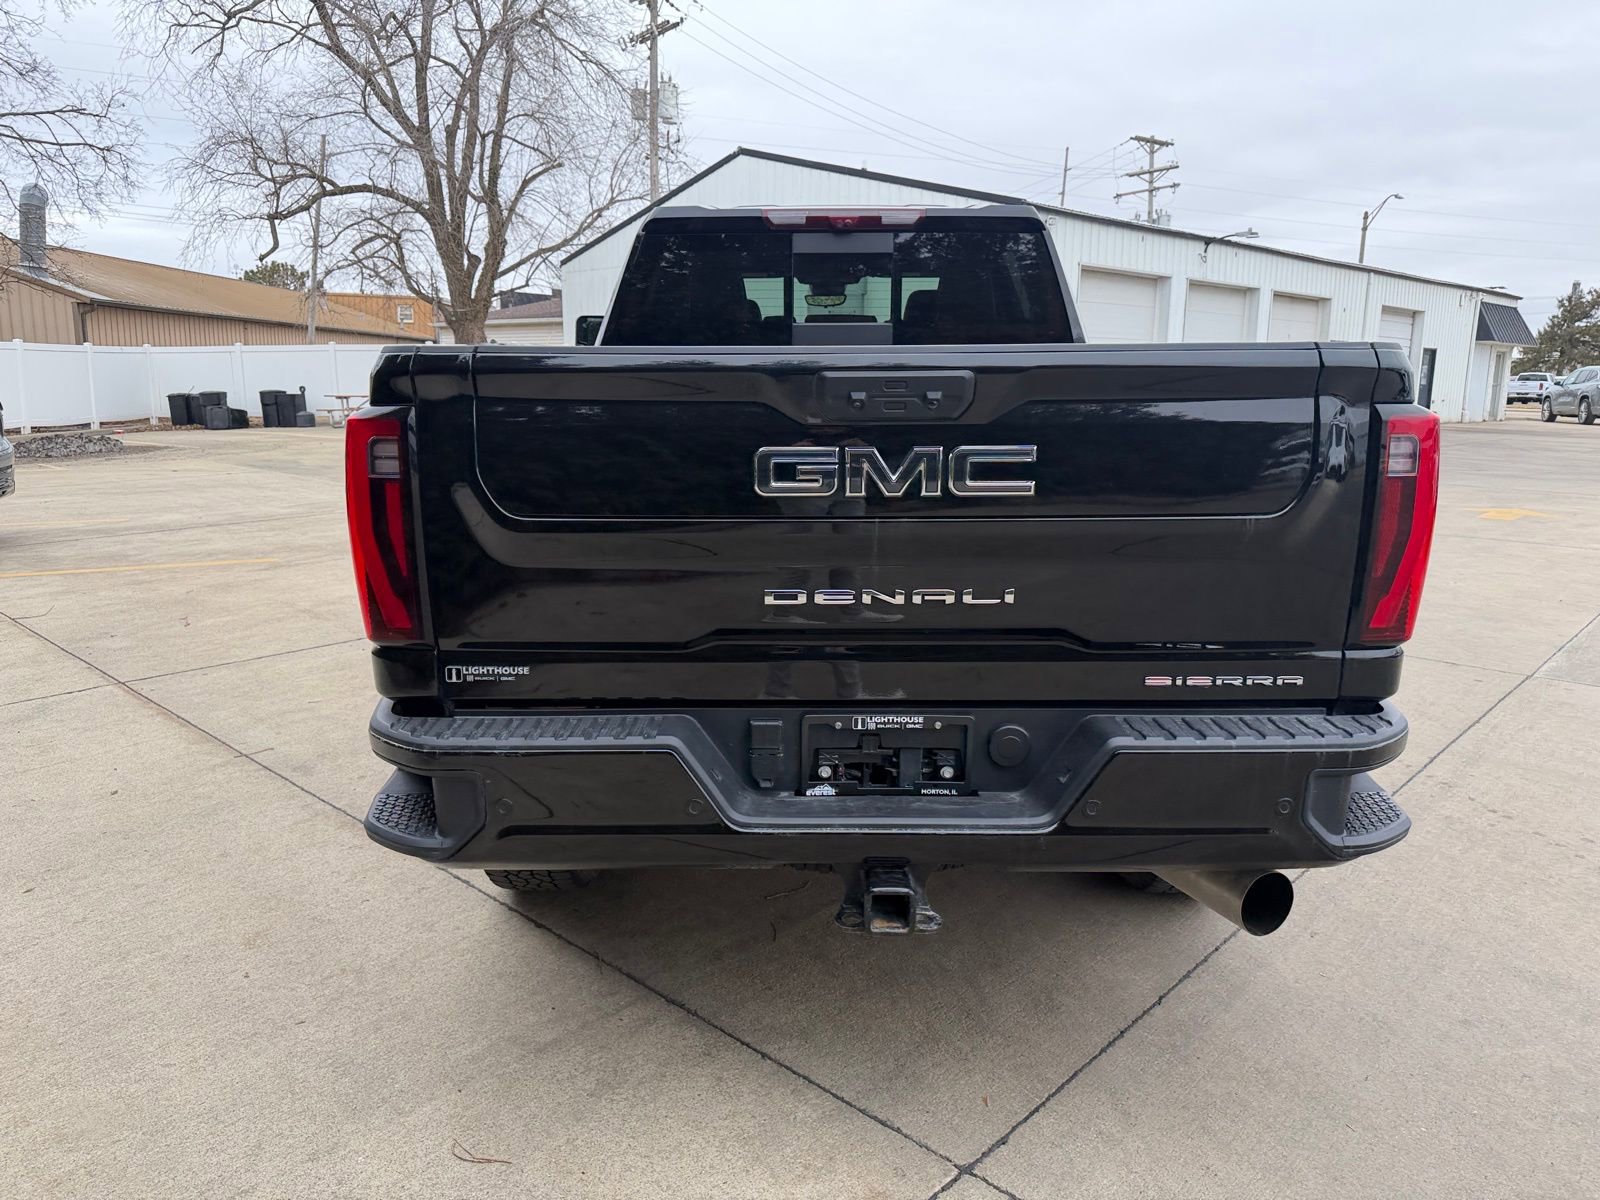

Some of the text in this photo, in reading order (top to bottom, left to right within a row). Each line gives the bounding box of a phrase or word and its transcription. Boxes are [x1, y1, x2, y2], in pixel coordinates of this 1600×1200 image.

[754, 444, 1037, 497] GMC
[764, 588, 1015, 605] DENALI
[462, 666, 530, 675] LIGHTHOUSE
[1144, 675, 1304, 687] SIERRA
[806, 788, 837, 796] everest
[921, 788, 951, 796] MORTON,
